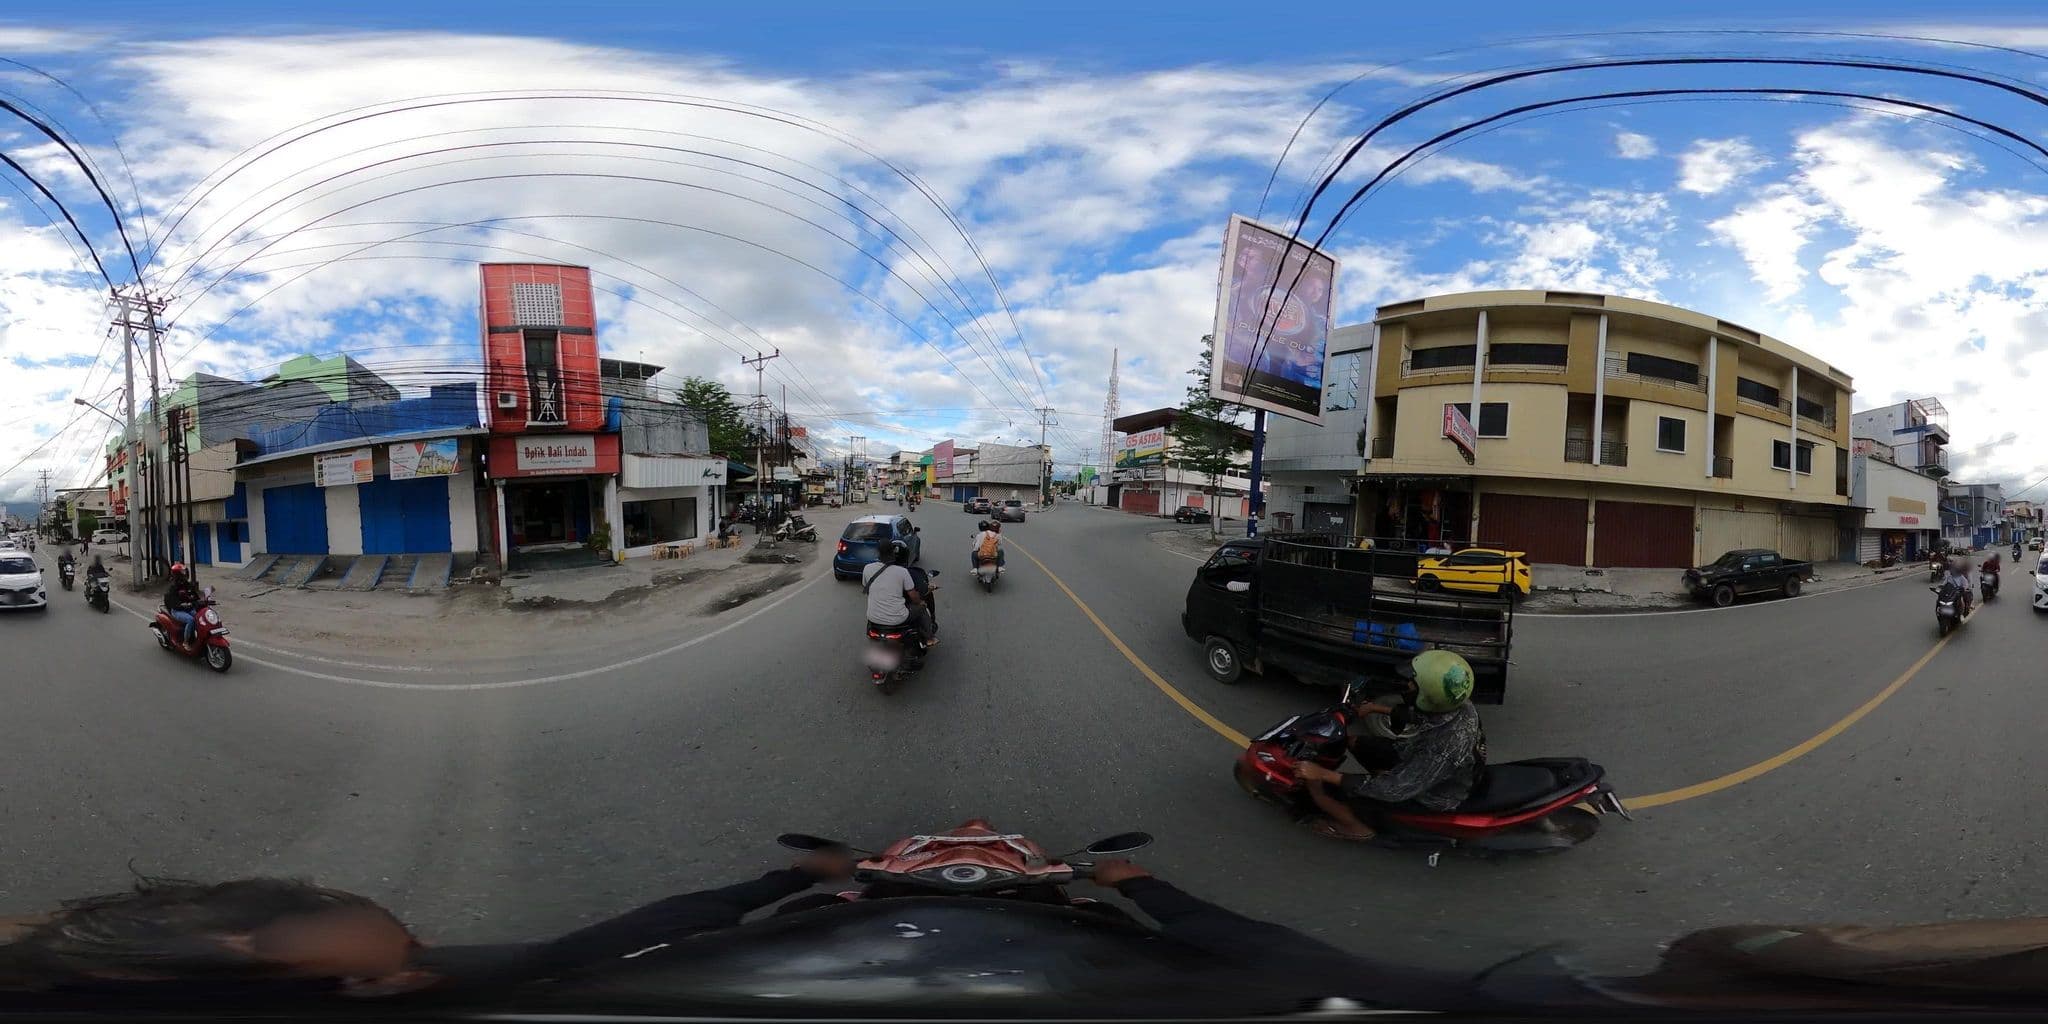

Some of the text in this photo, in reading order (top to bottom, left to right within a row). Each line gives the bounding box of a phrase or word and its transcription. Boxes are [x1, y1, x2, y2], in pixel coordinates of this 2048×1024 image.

[1125, 435, 1137, 448] GS
[1138, 432, 1162, 446] ASTRA
[524, 445, 588, 460] Optik Bali Indah
